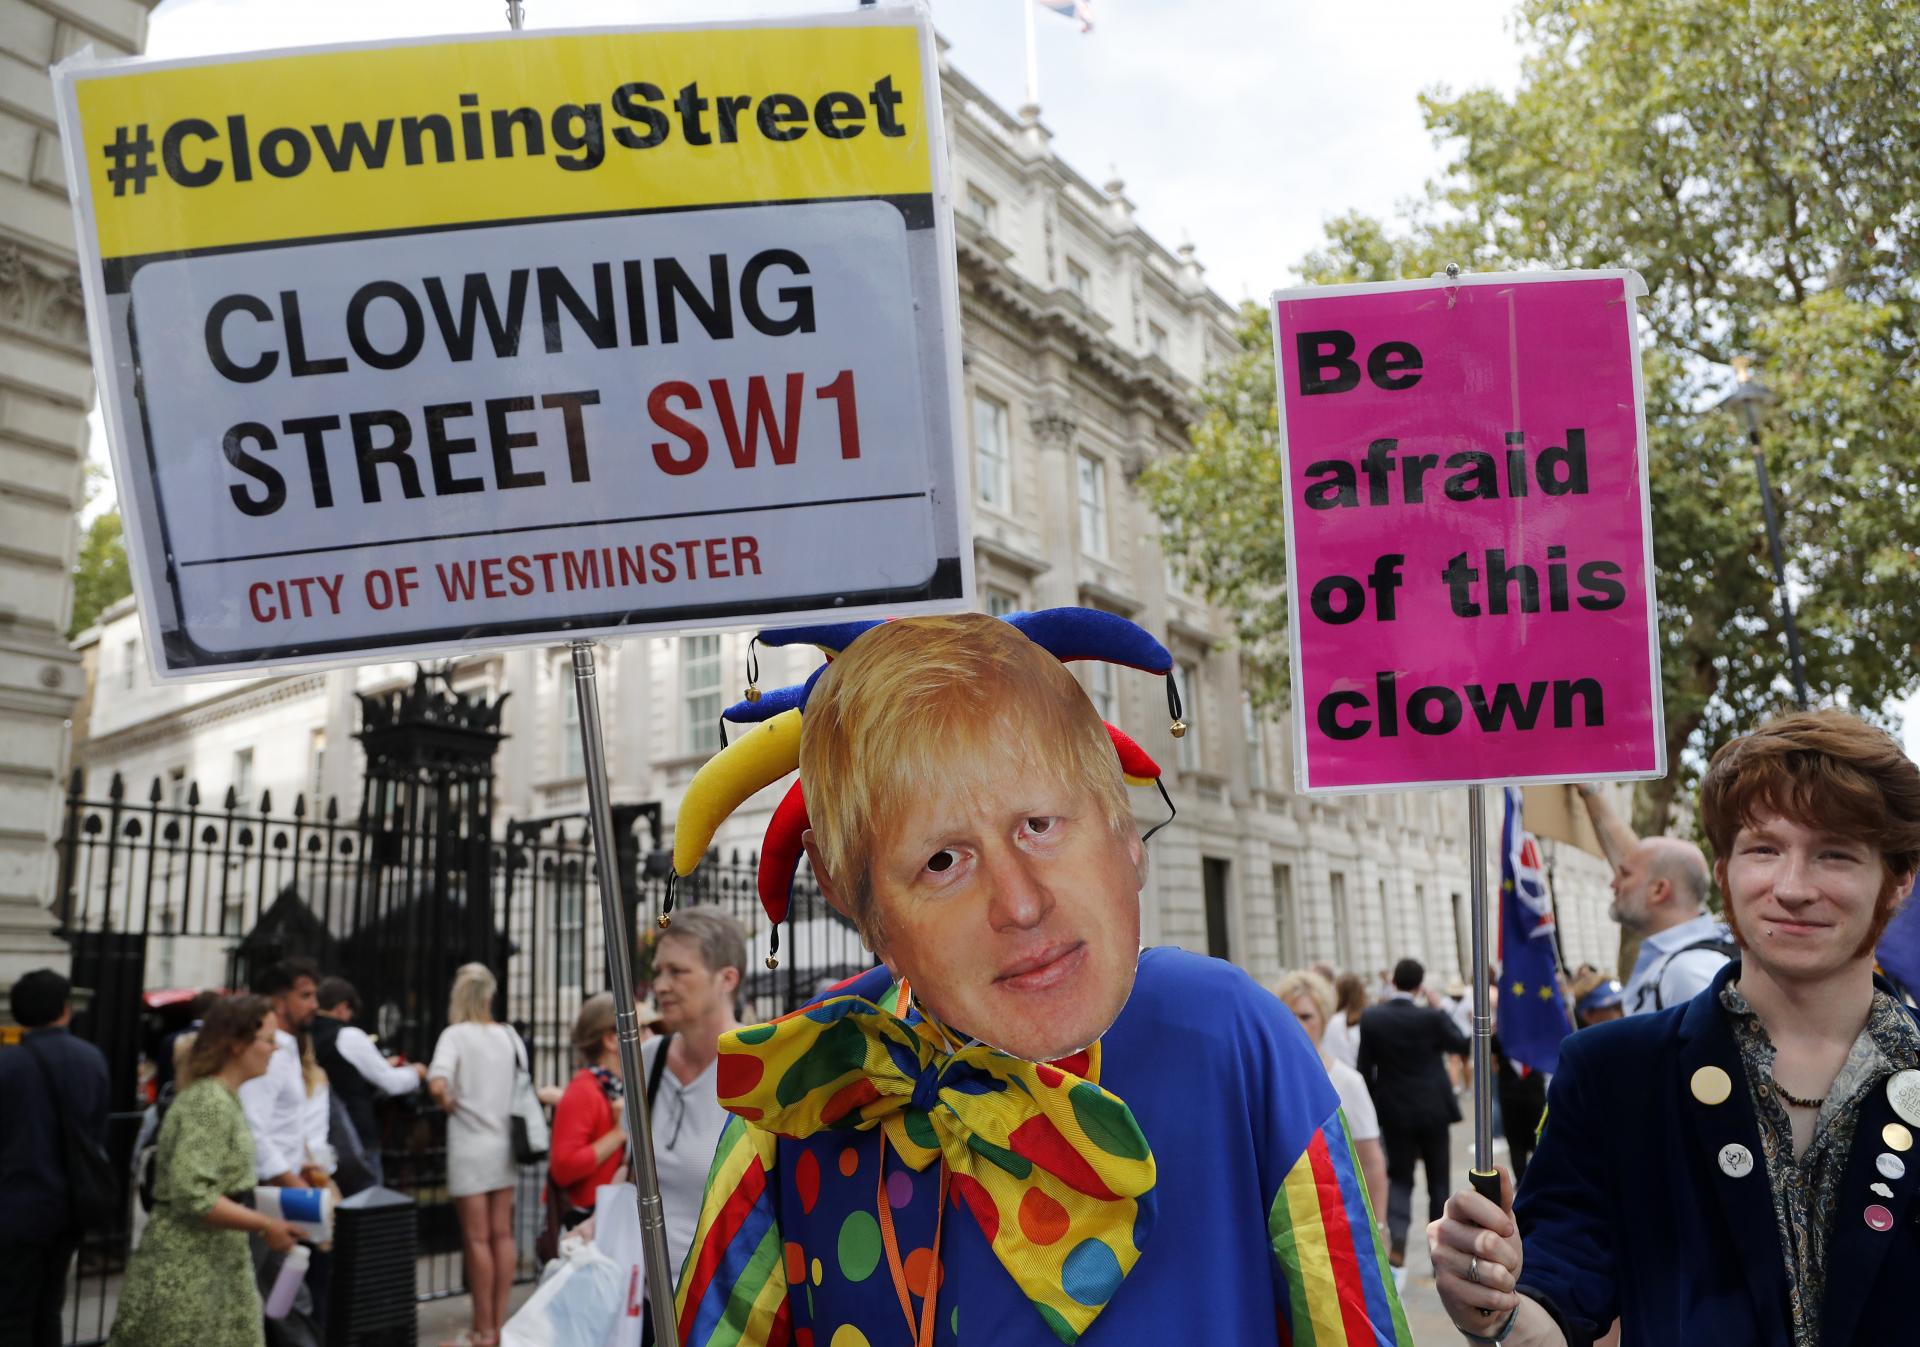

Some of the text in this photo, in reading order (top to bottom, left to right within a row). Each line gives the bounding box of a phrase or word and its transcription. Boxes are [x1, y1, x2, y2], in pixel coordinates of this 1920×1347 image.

[102, 74, 906, 198] #ClowningStreet
[204, 247, 817, 385] CLOWNING
[1295, 329, 1424, 397] Be
[222, 370, 861, 518] STREET SW1
[1303, 428, 1590, 511] afraid
[248, 535, 763, 624] CITY OF WESTMINSTER
[1310, 545, 1627, 626] of this
[1316, 670, 1605, 741] clown
